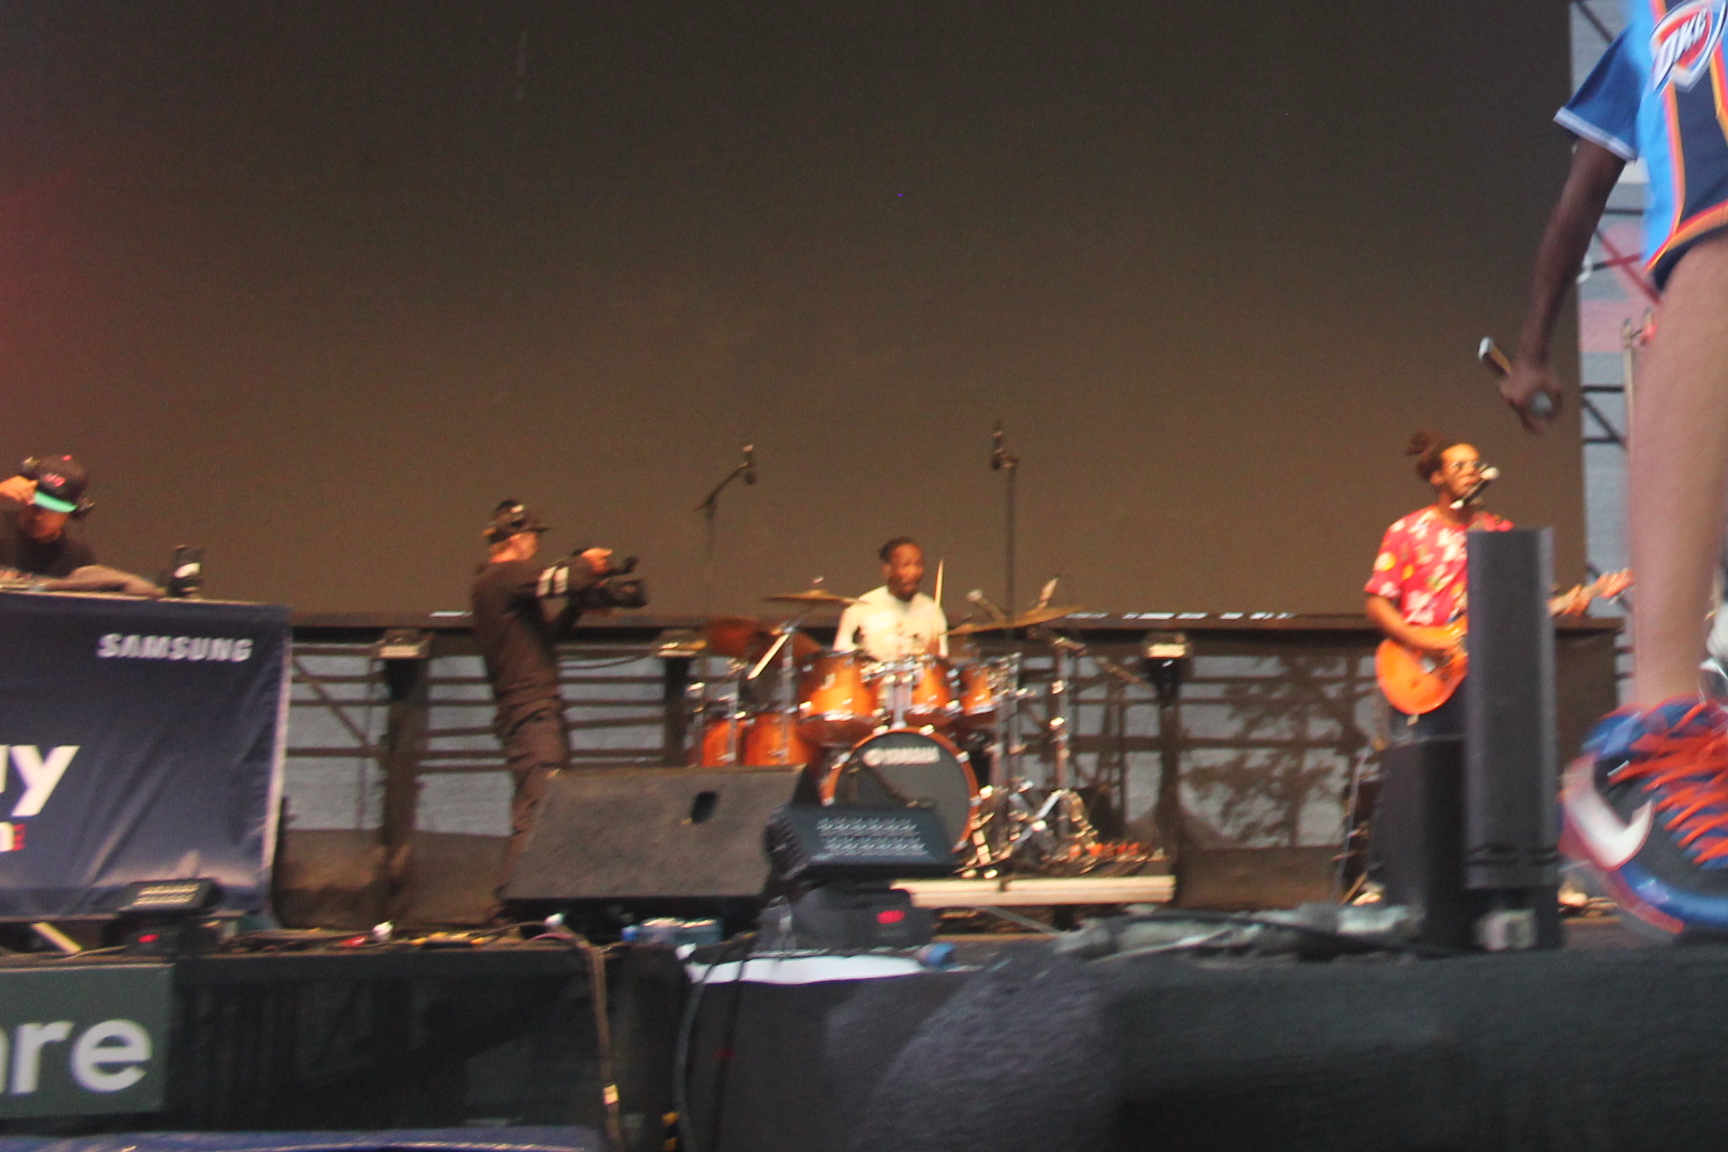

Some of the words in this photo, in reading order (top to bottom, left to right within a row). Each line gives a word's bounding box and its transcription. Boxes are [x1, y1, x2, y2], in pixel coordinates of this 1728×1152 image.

[97, 632, 254, 663] SAMSUNG
[0, 744, 81, 817] y
[0, 1019, 153, 1095] re
